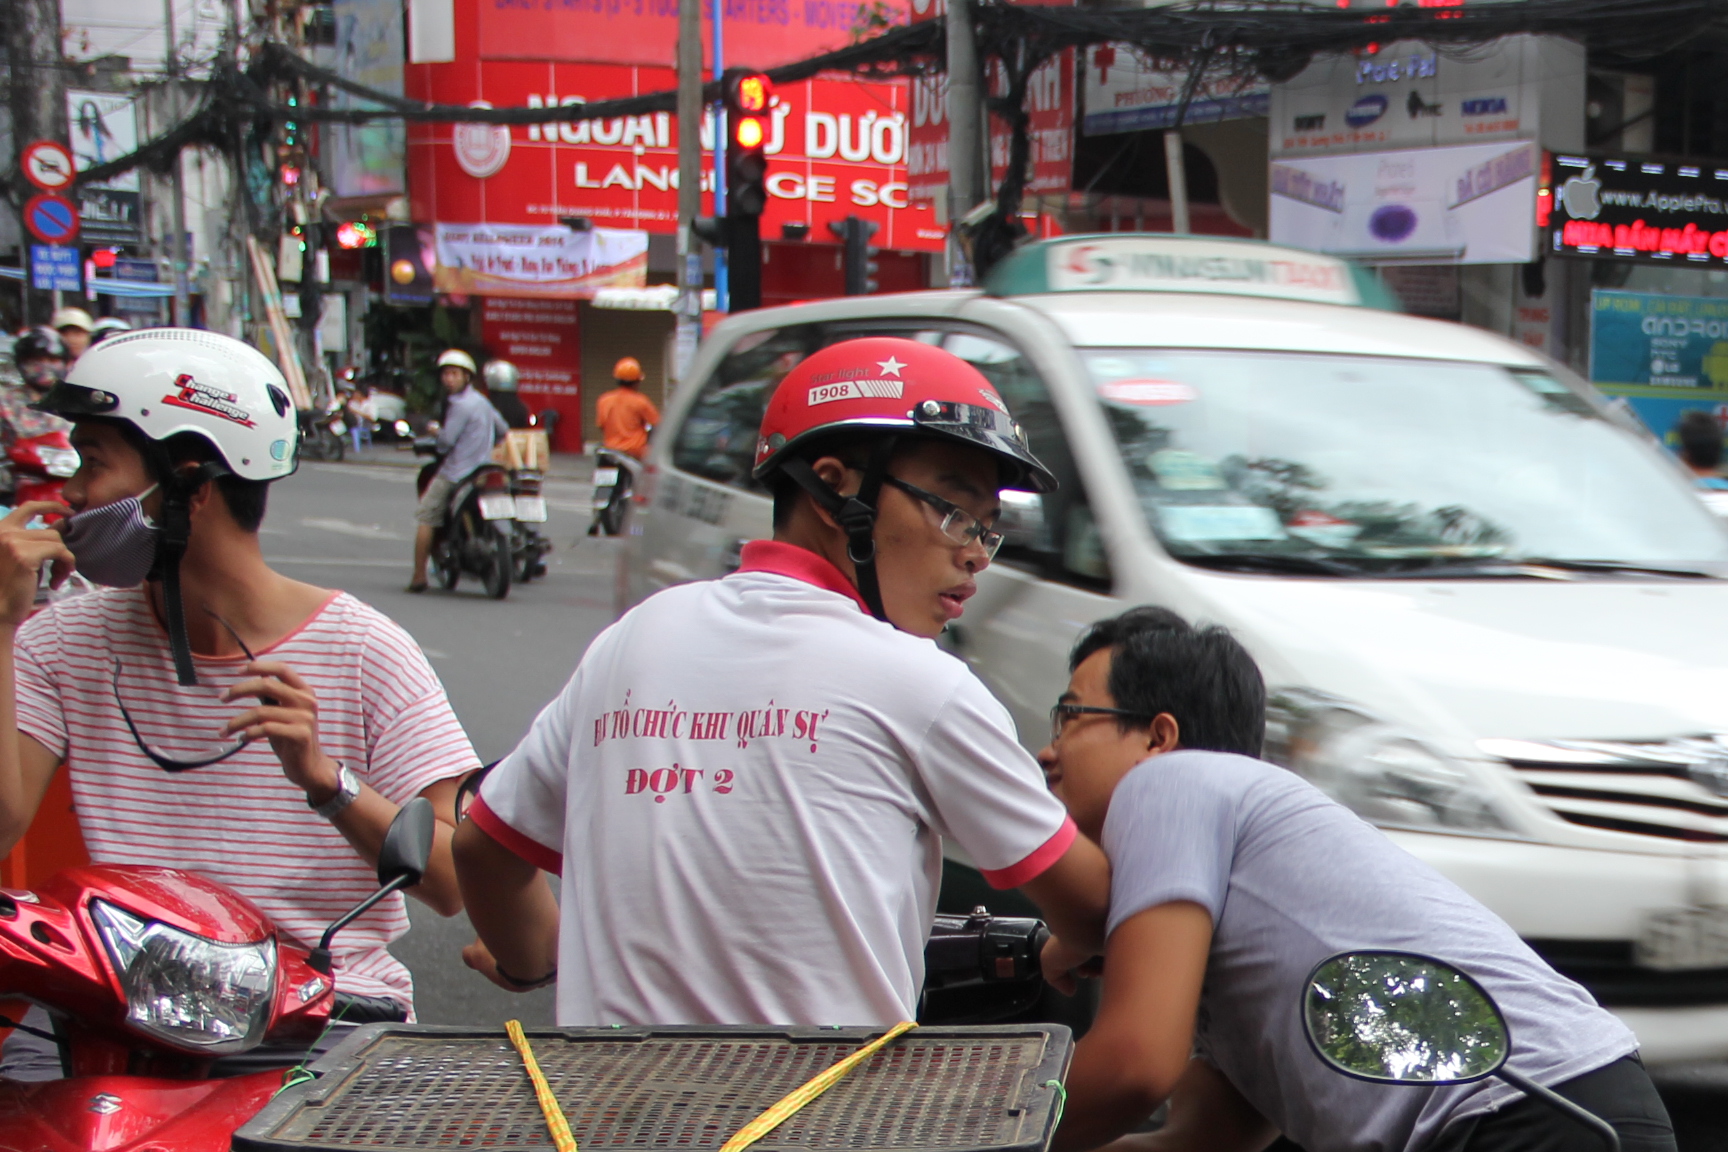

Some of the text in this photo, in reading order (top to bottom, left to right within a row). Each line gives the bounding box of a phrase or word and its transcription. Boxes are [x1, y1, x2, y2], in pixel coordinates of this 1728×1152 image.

[805, 109, 910, 166] DƯƠ
[174, 373, 230, 400] Change
[810, 366, 870, 385] Star light
[178, 387, 250, 421] Challenge
[810, 384, 851, 402] 1908
[633, 698, 689, 740] CHỨC
[688, 711, 735, 741] KHU
[737, 698, 790, 750] QUÂN
[792, 708, 830, 754] SỰ
[624, 762, 735, 804] ĐỢT 2
